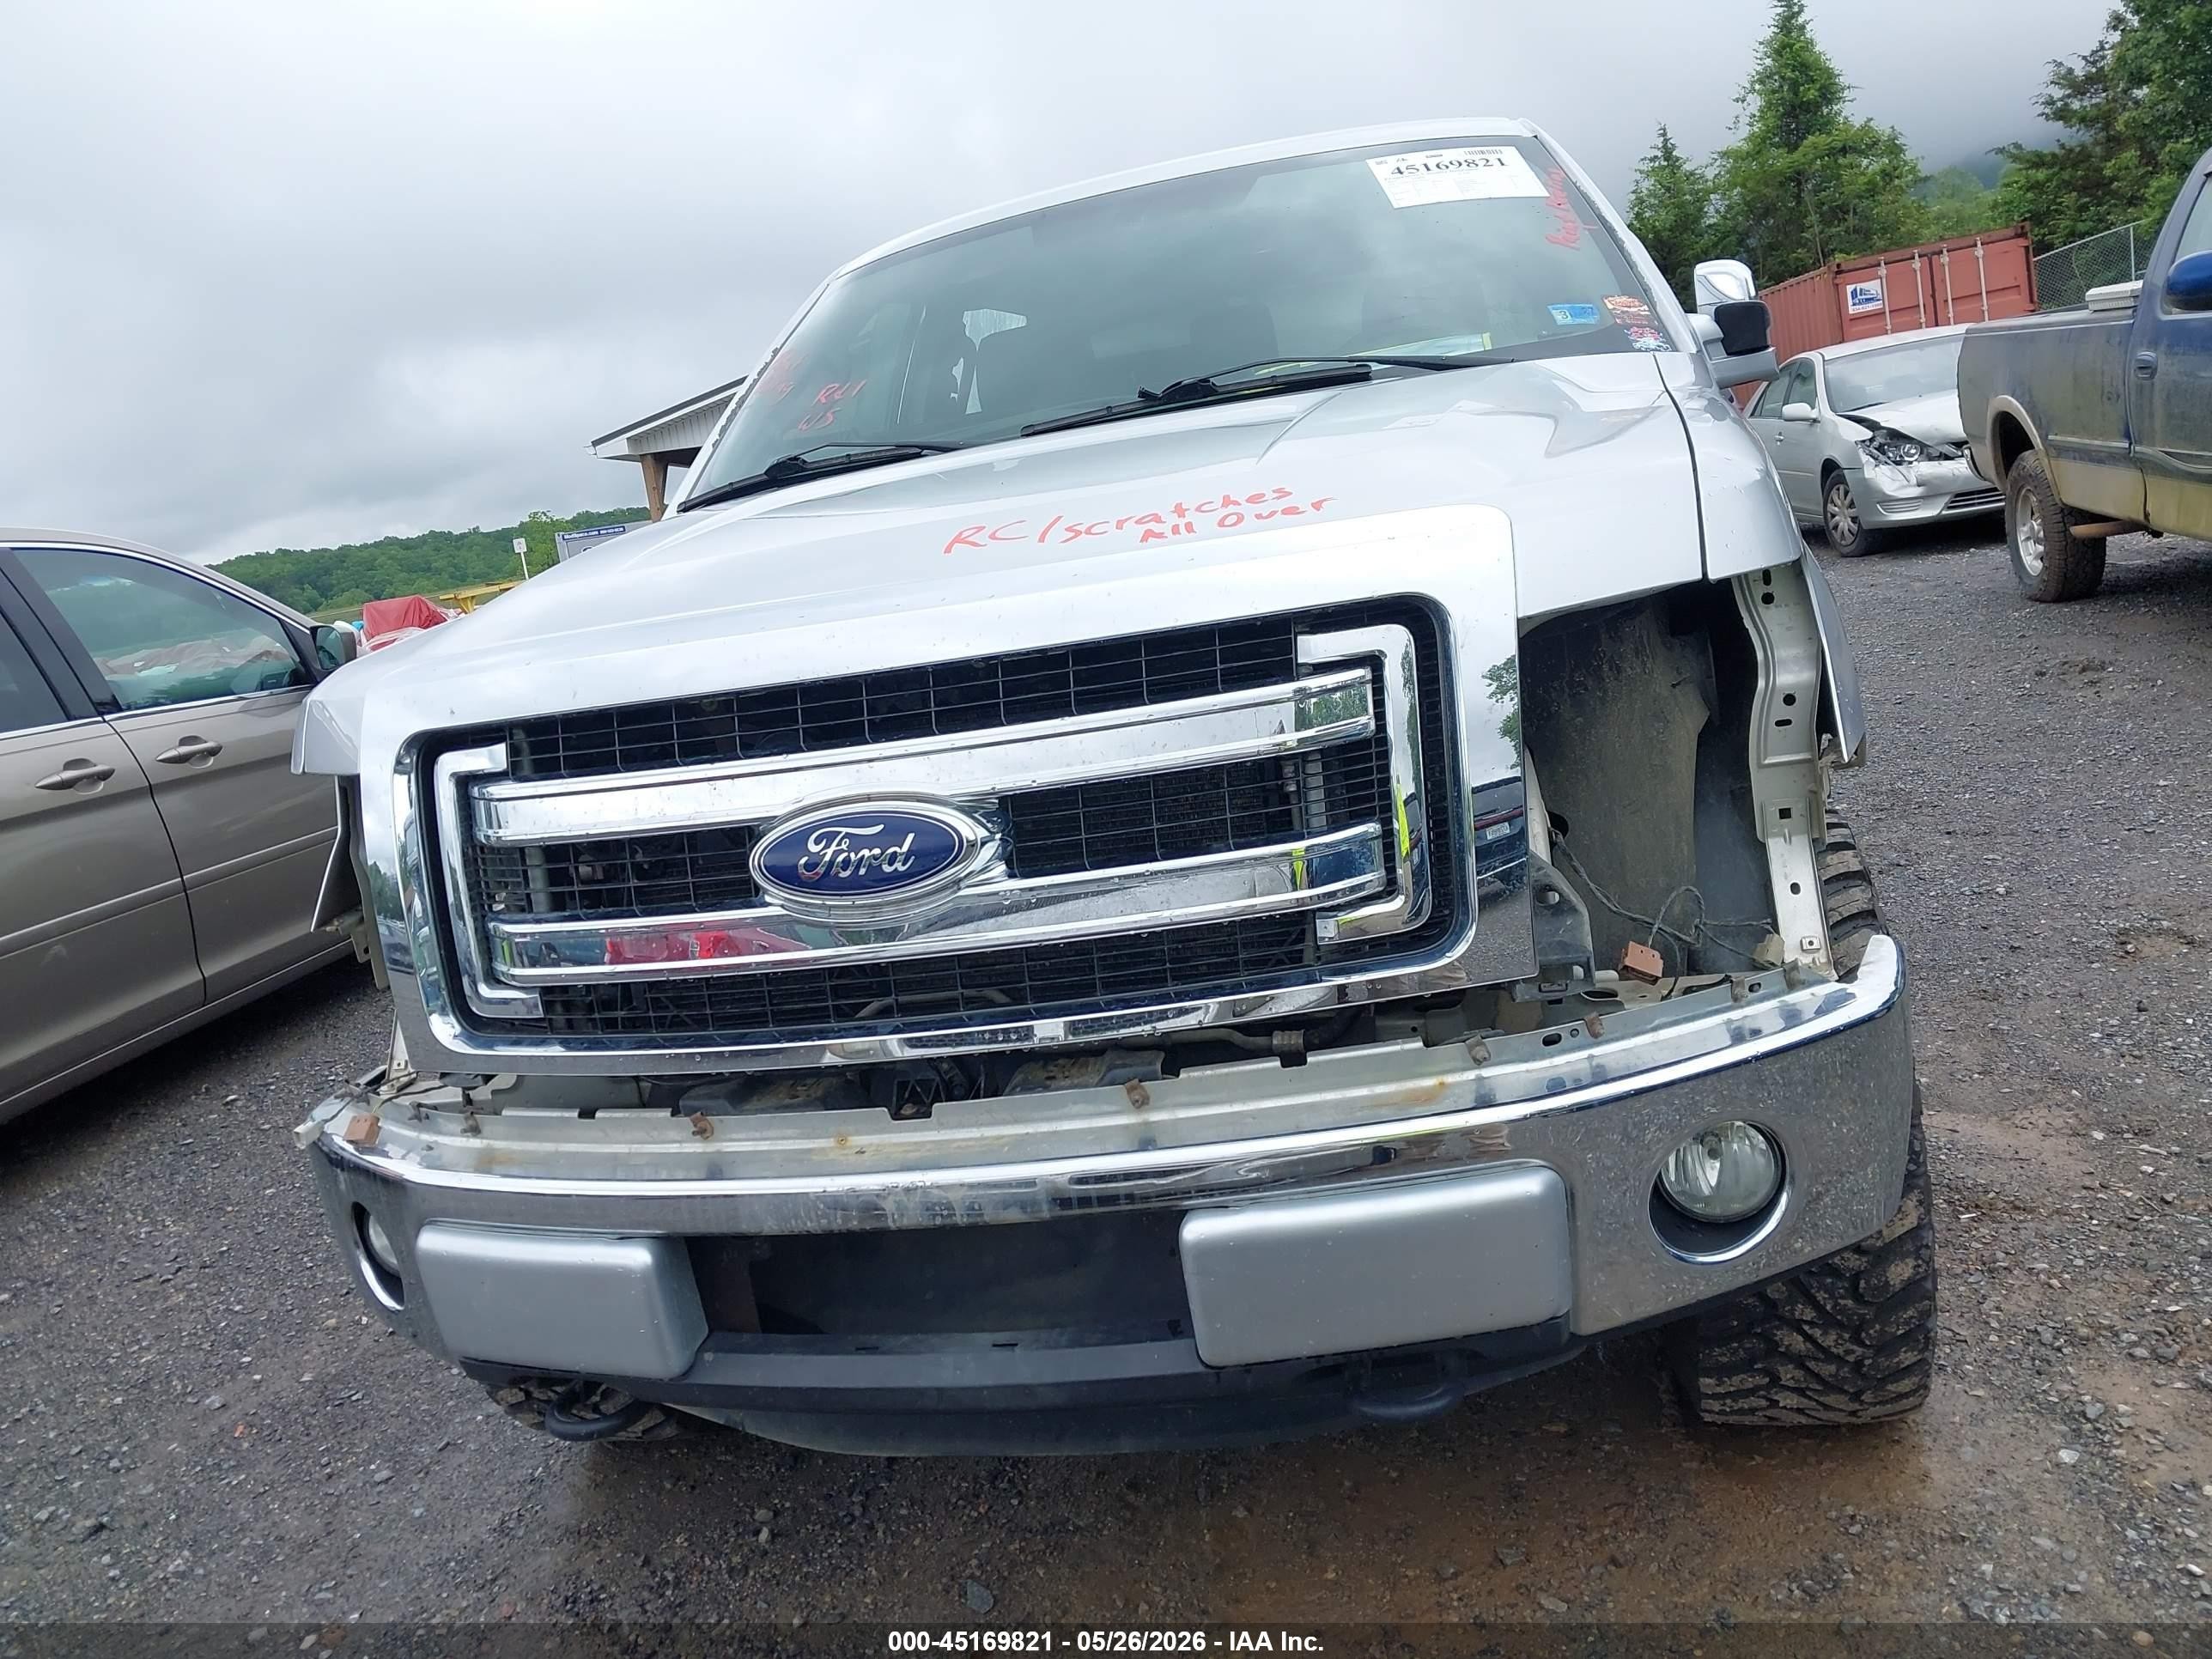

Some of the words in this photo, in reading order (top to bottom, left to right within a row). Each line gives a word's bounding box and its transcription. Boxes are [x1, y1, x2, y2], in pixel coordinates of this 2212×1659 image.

[1390, 156, 1510, 176] 45169821
[1216, 496, 1338, 529] Over
[797, 823, 916, 883] Ford
